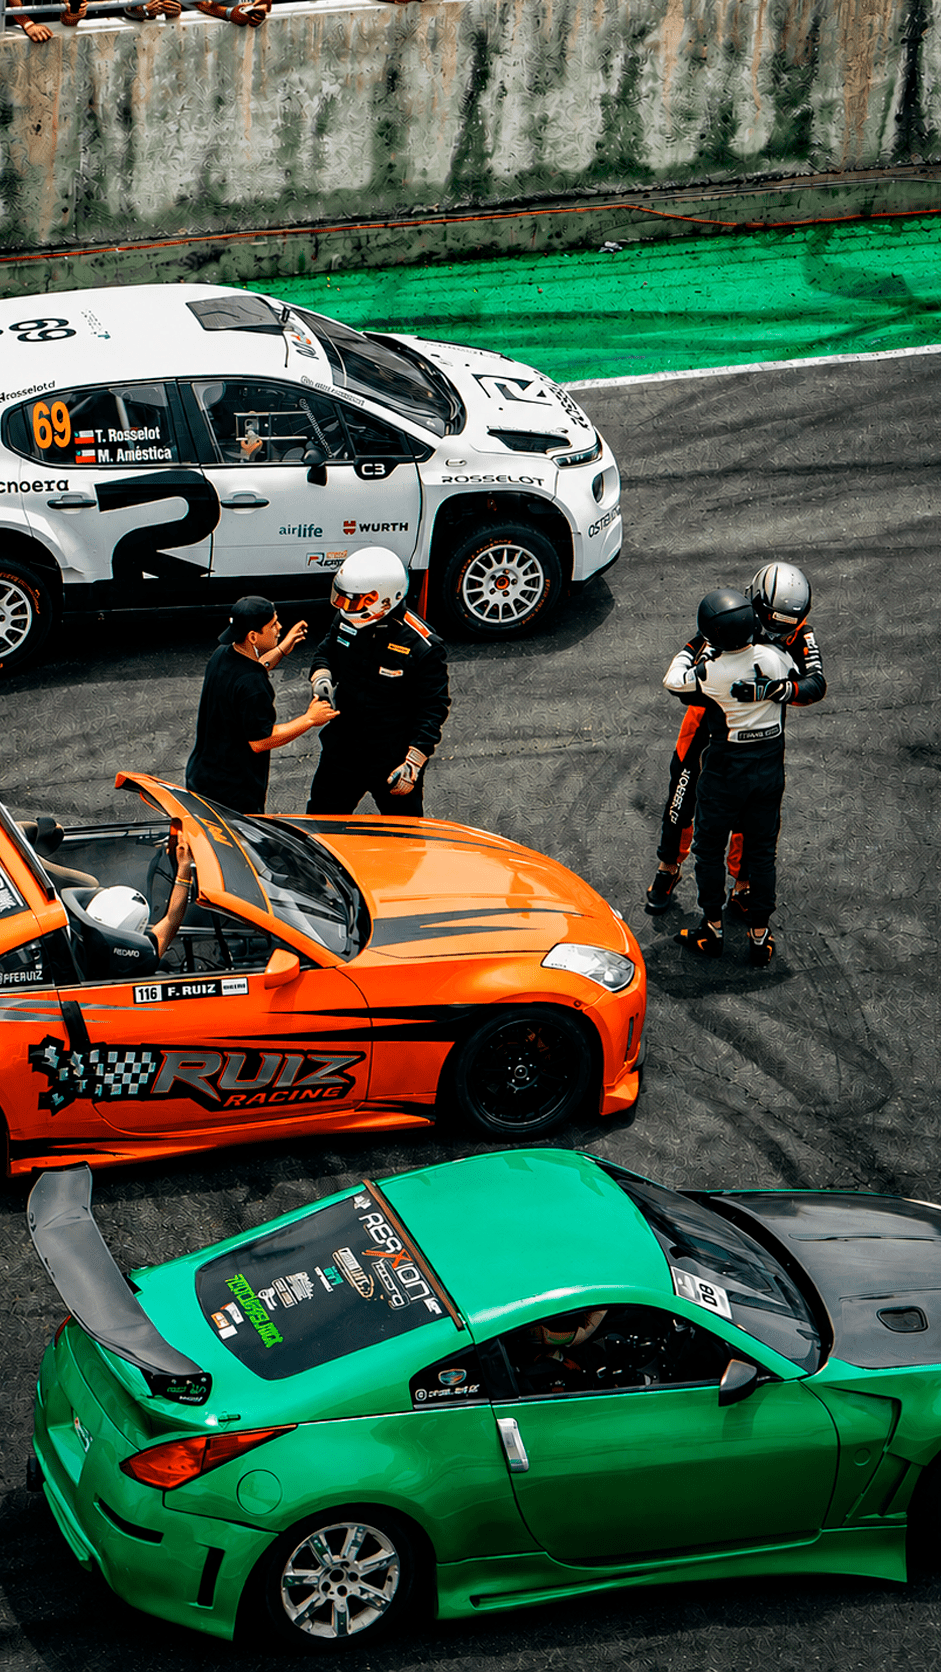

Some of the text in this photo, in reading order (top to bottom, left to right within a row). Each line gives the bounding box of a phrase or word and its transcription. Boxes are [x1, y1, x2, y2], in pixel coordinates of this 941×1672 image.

[32, 400, 72, 450] 69
[95, 426, 161, 444] T. Rosselot
[97, 446, 172, 463] M. Améstica
[360, 463, 386, 476] C3
[441, 474, 545, 487] ROSSELOT
[279, 523, 323, 538] airlife
[138, 986, 158, 1001] 116
[167, 985, 180, 997] F.
[182, 983, 216, 996] RUIZ
[150, 1050, 361, 1102] RUIZ
[222, 1086, 344, 1108] RACING
